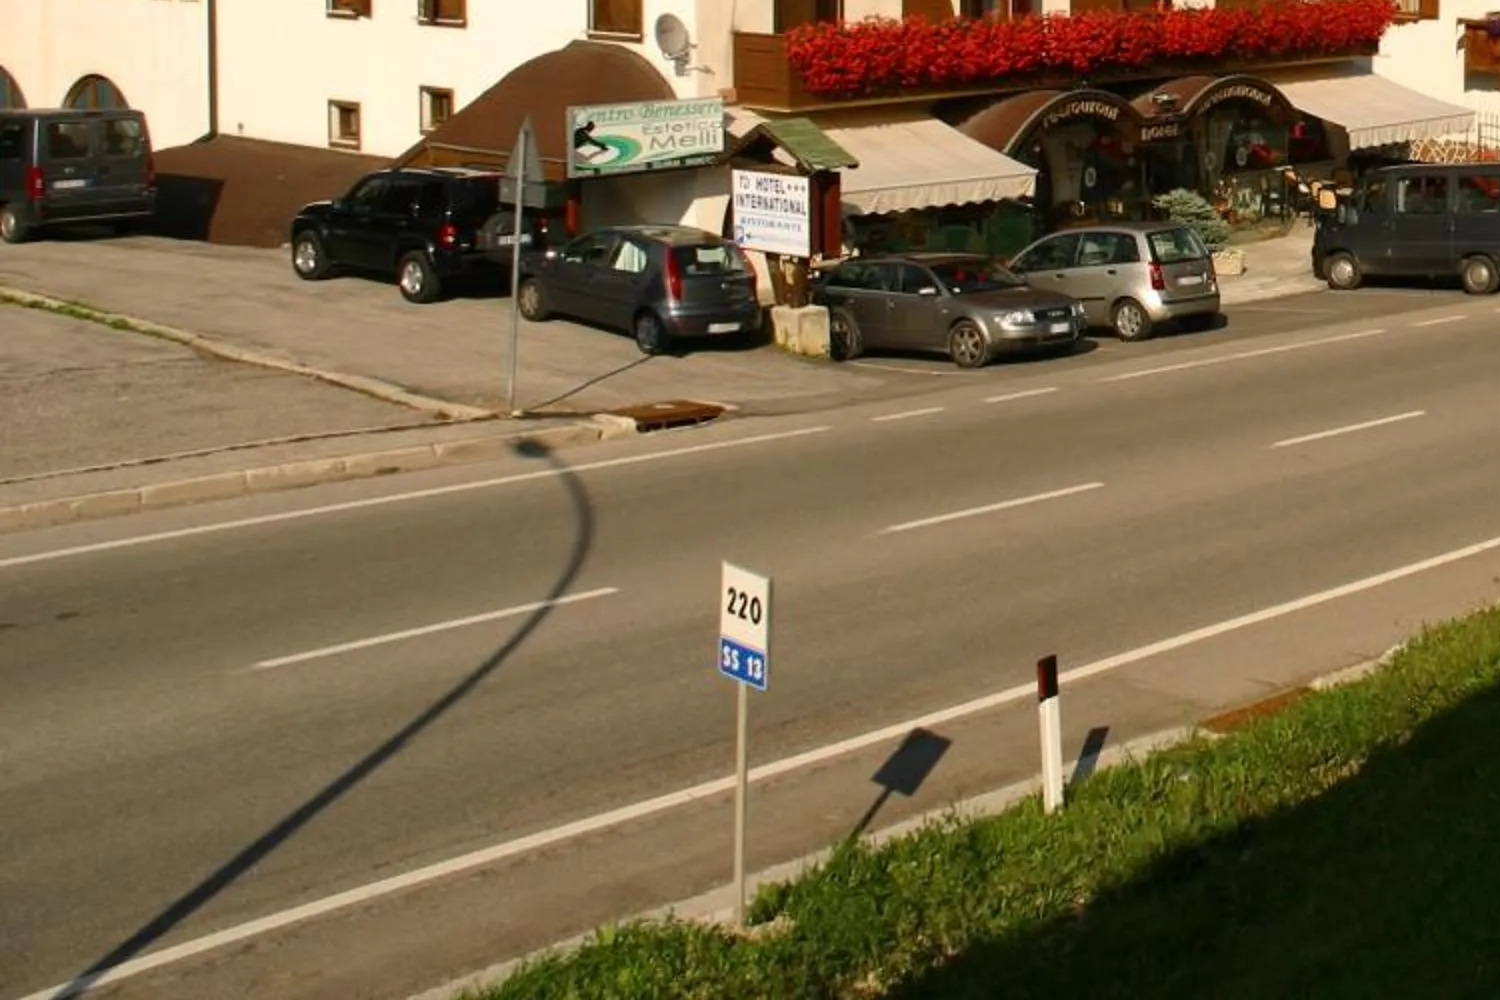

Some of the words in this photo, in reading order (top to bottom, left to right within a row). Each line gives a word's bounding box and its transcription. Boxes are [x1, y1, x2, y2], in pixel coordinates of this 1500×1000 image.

[736, 193, 806, 216] INTERNATIONAL
[727, 586, 762, 625] 220
[723, 645, 739, 670] SS
[747, 656, 762, 680] 13
